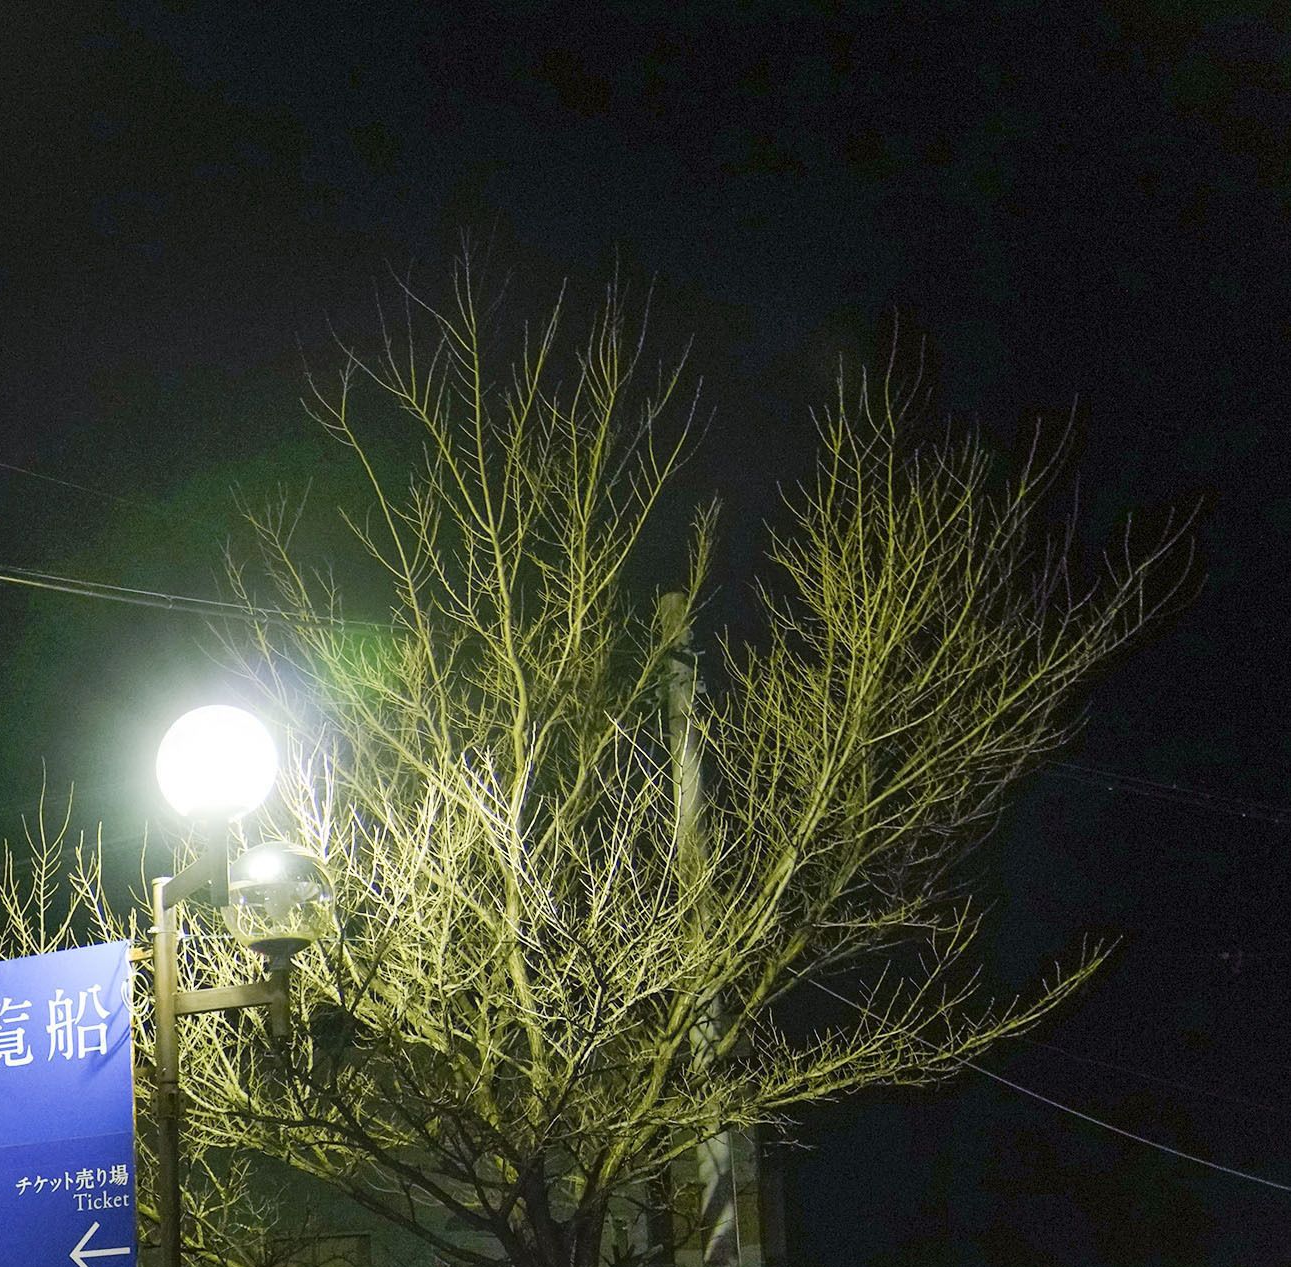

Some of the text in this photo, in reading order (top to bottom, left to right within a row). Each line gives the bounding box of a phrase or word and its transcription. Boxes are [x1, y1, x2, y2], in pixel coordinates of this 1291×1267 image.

[15, 1164, 129, 1196] チケット売り場
[73, 1190, 130, 1211] Ticket
